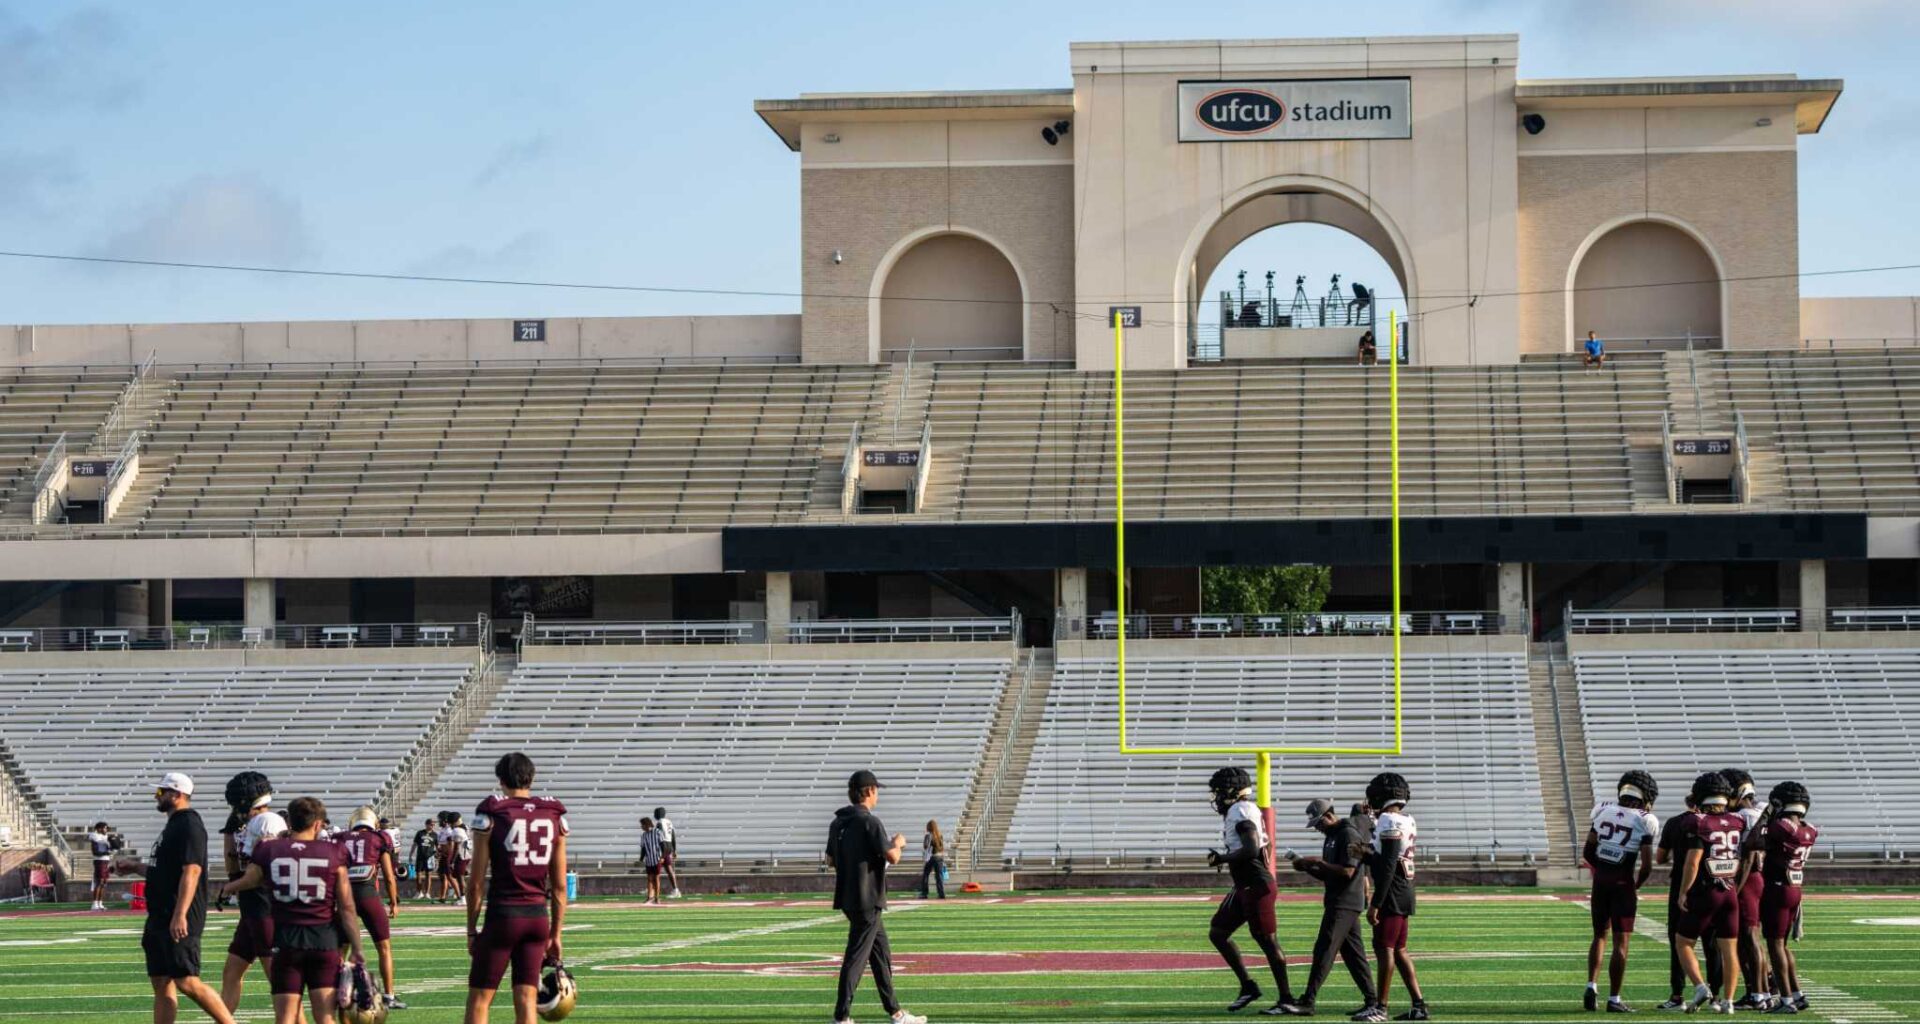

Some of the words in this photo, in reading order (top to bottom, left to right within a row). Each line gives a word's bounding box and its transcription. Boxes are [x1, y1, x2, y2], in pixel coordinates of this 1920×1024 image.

[1211, 98, 1270, 122] ufcu
[1292, 100, 1392, 121] stadium
[521, 327, 538, 340] 211
[1682, 445, 1697, 453] 212
[80, 466, 95, 474] 210
[503, 818, 554, 866] 43
[1598, 820, 1633, 847] 27
[1709, 830, 1740, 860] 29
[270, 857, 329, 904] 95
